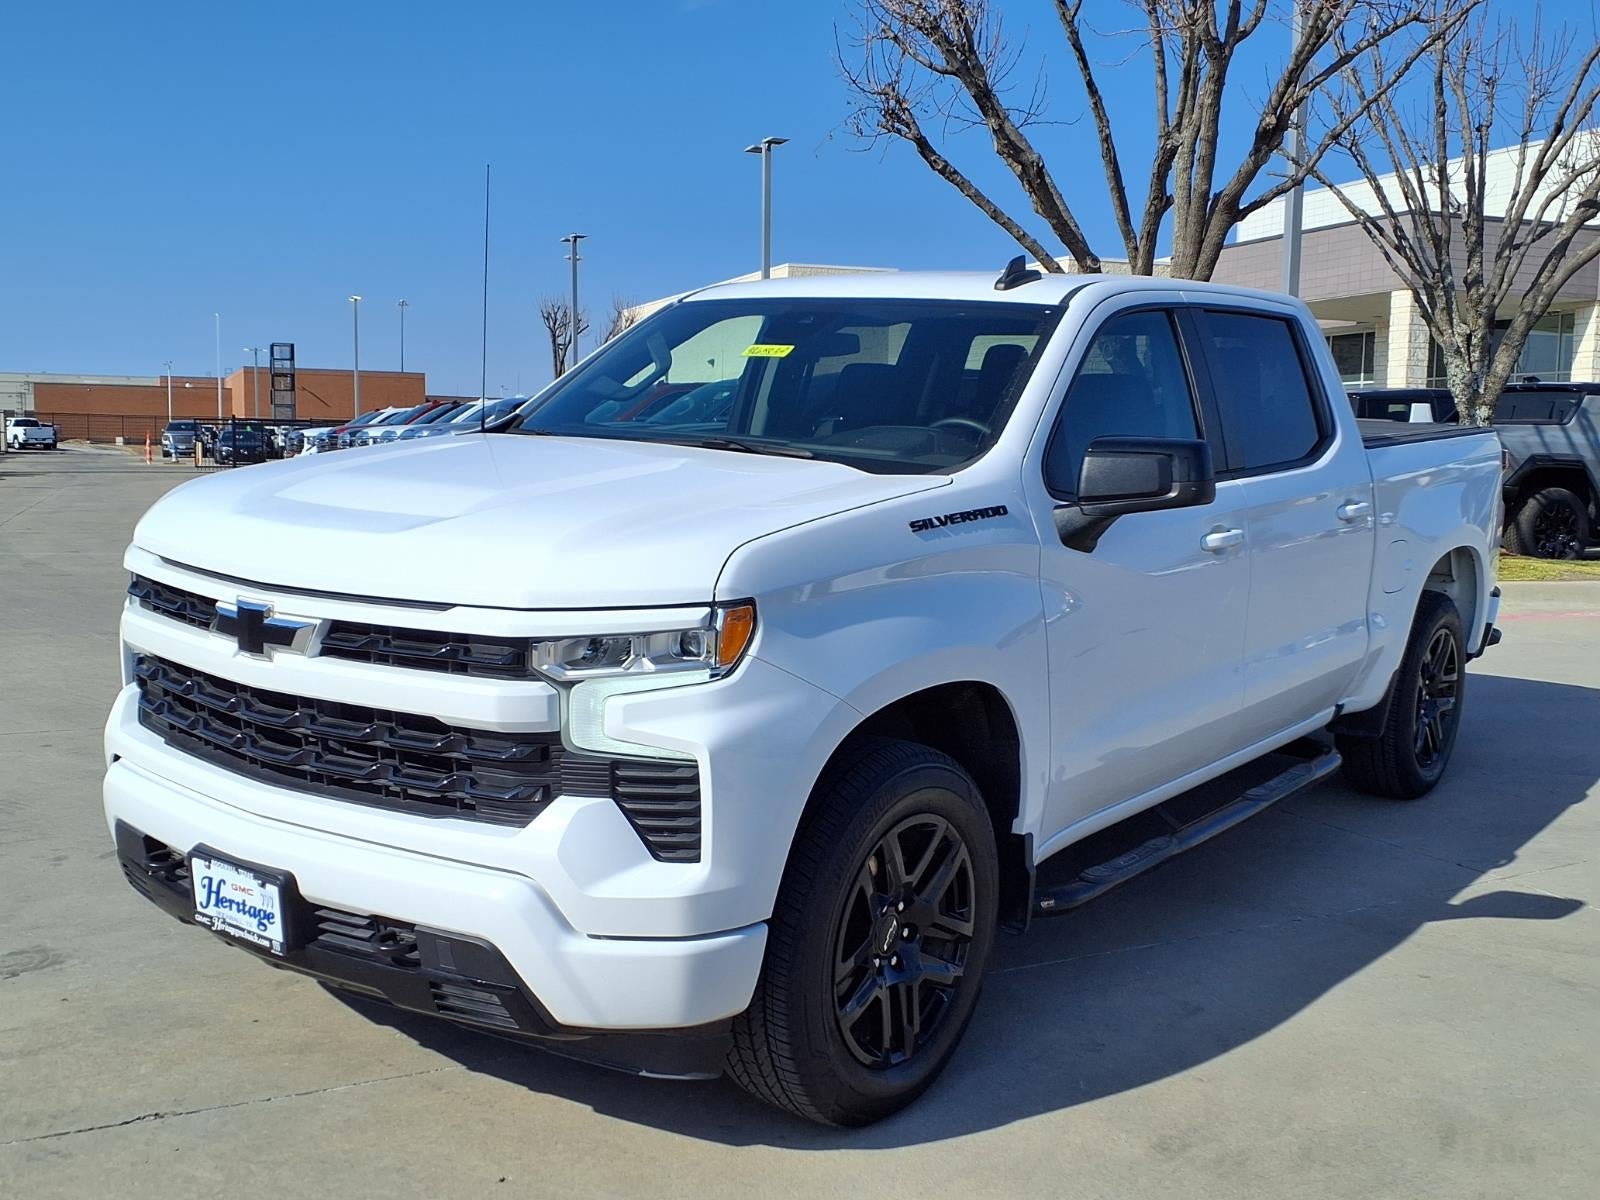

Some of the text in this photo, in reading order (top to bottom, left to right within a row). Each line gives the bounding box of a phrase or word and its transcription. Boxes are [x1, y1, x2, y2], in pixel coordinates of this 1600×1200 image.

[909, 504, 1009, 533] SILVERADO
[199, 875, 275, 932] Heritage
[231, 883, 254, 896] GMC
